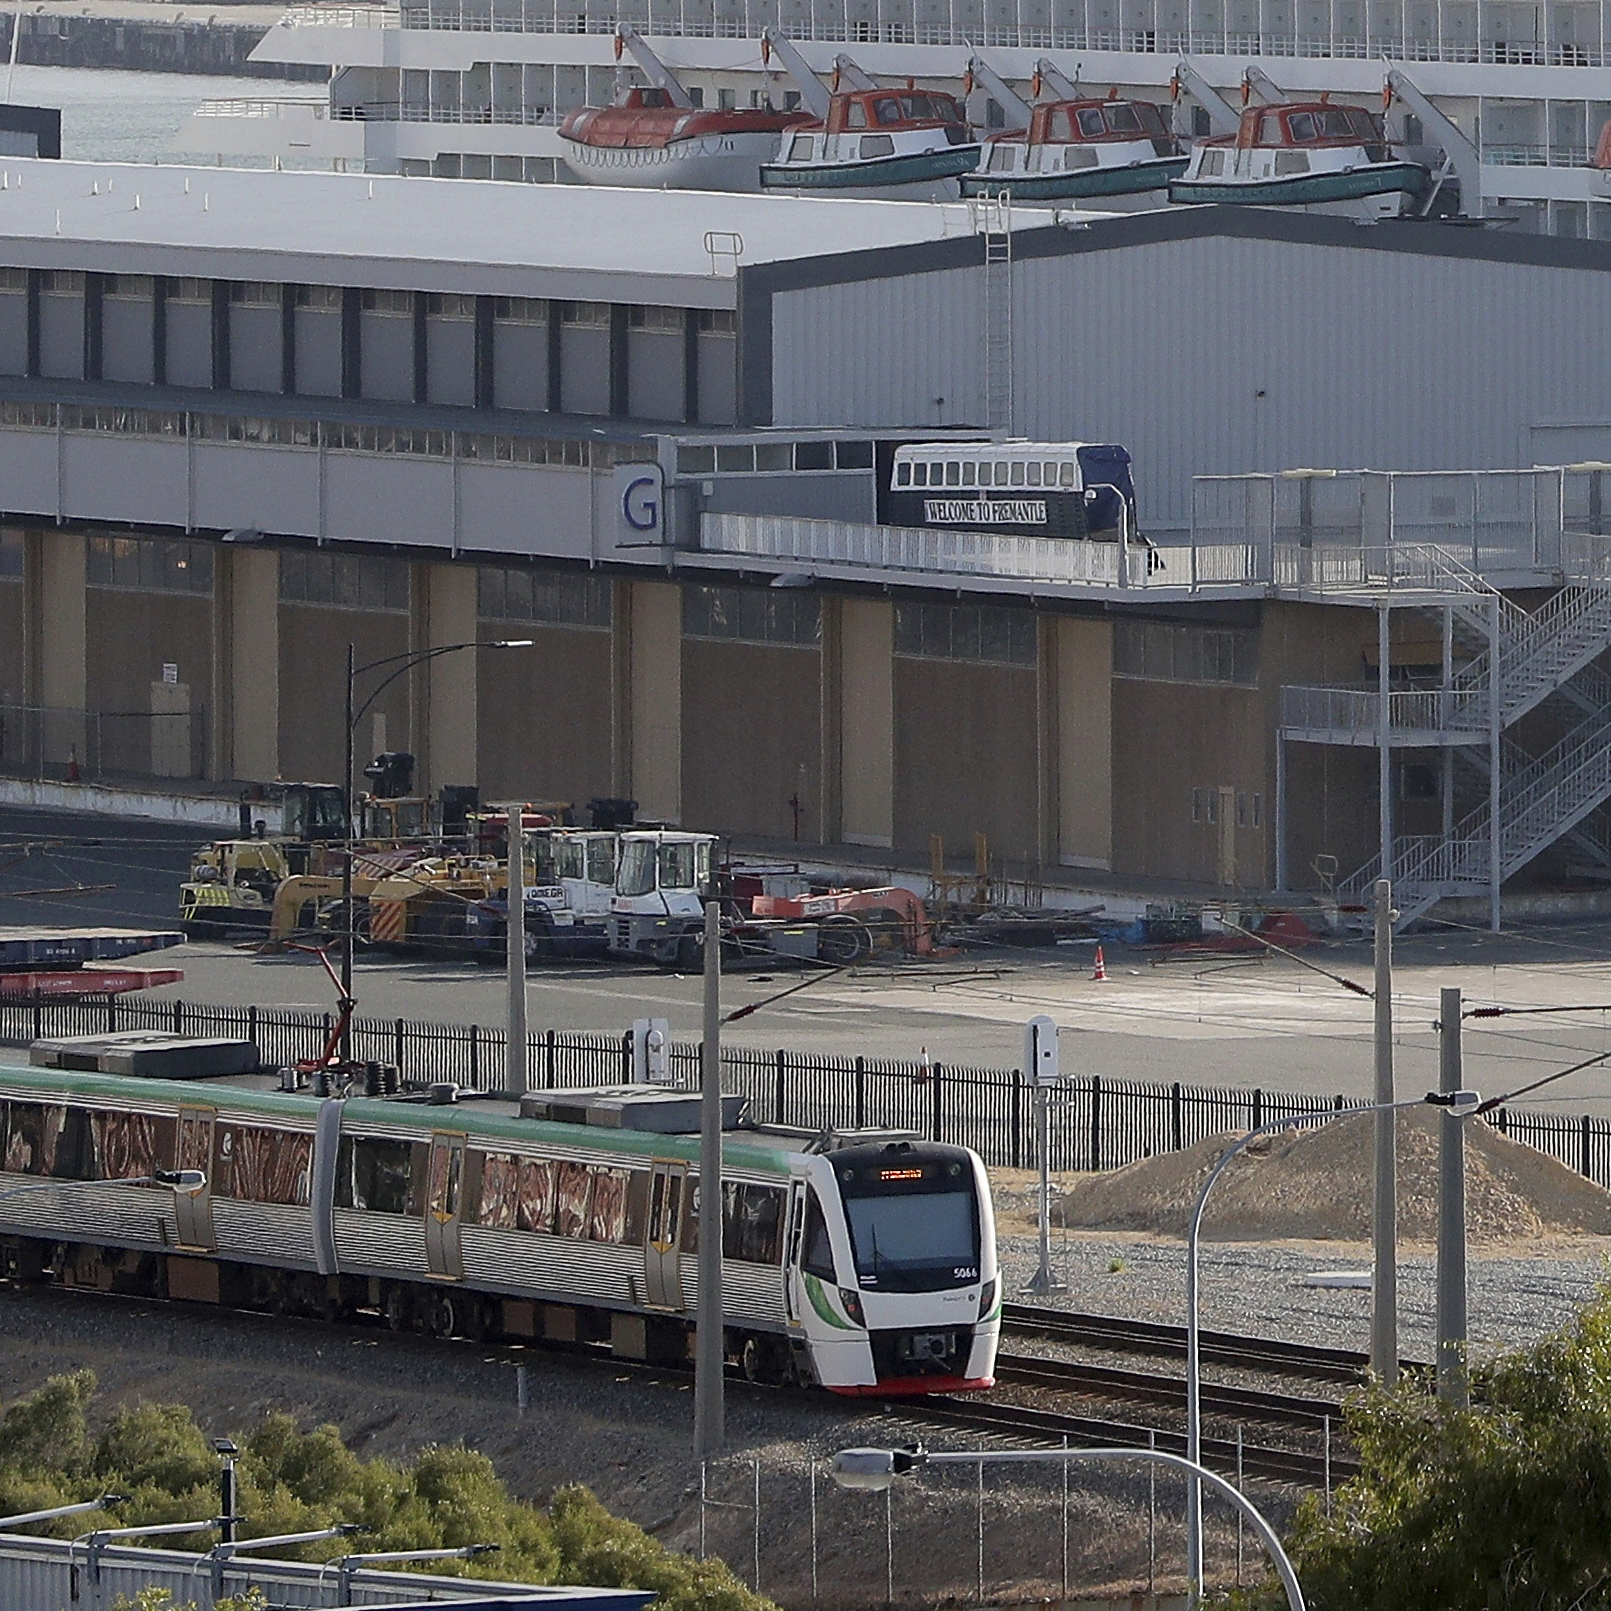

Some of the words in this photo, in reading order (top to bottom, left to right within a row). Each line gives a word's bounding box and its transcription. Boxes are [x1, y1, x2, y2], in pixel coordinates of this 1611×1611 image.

[621, 476, 657, 530] G
[928, 501, 976, 522] WELCOME
[977, 501, 991, 522] TO
[992, 502, 1046, 522] FREMANTLE
[953, 1267, 978, 1279] 5066
